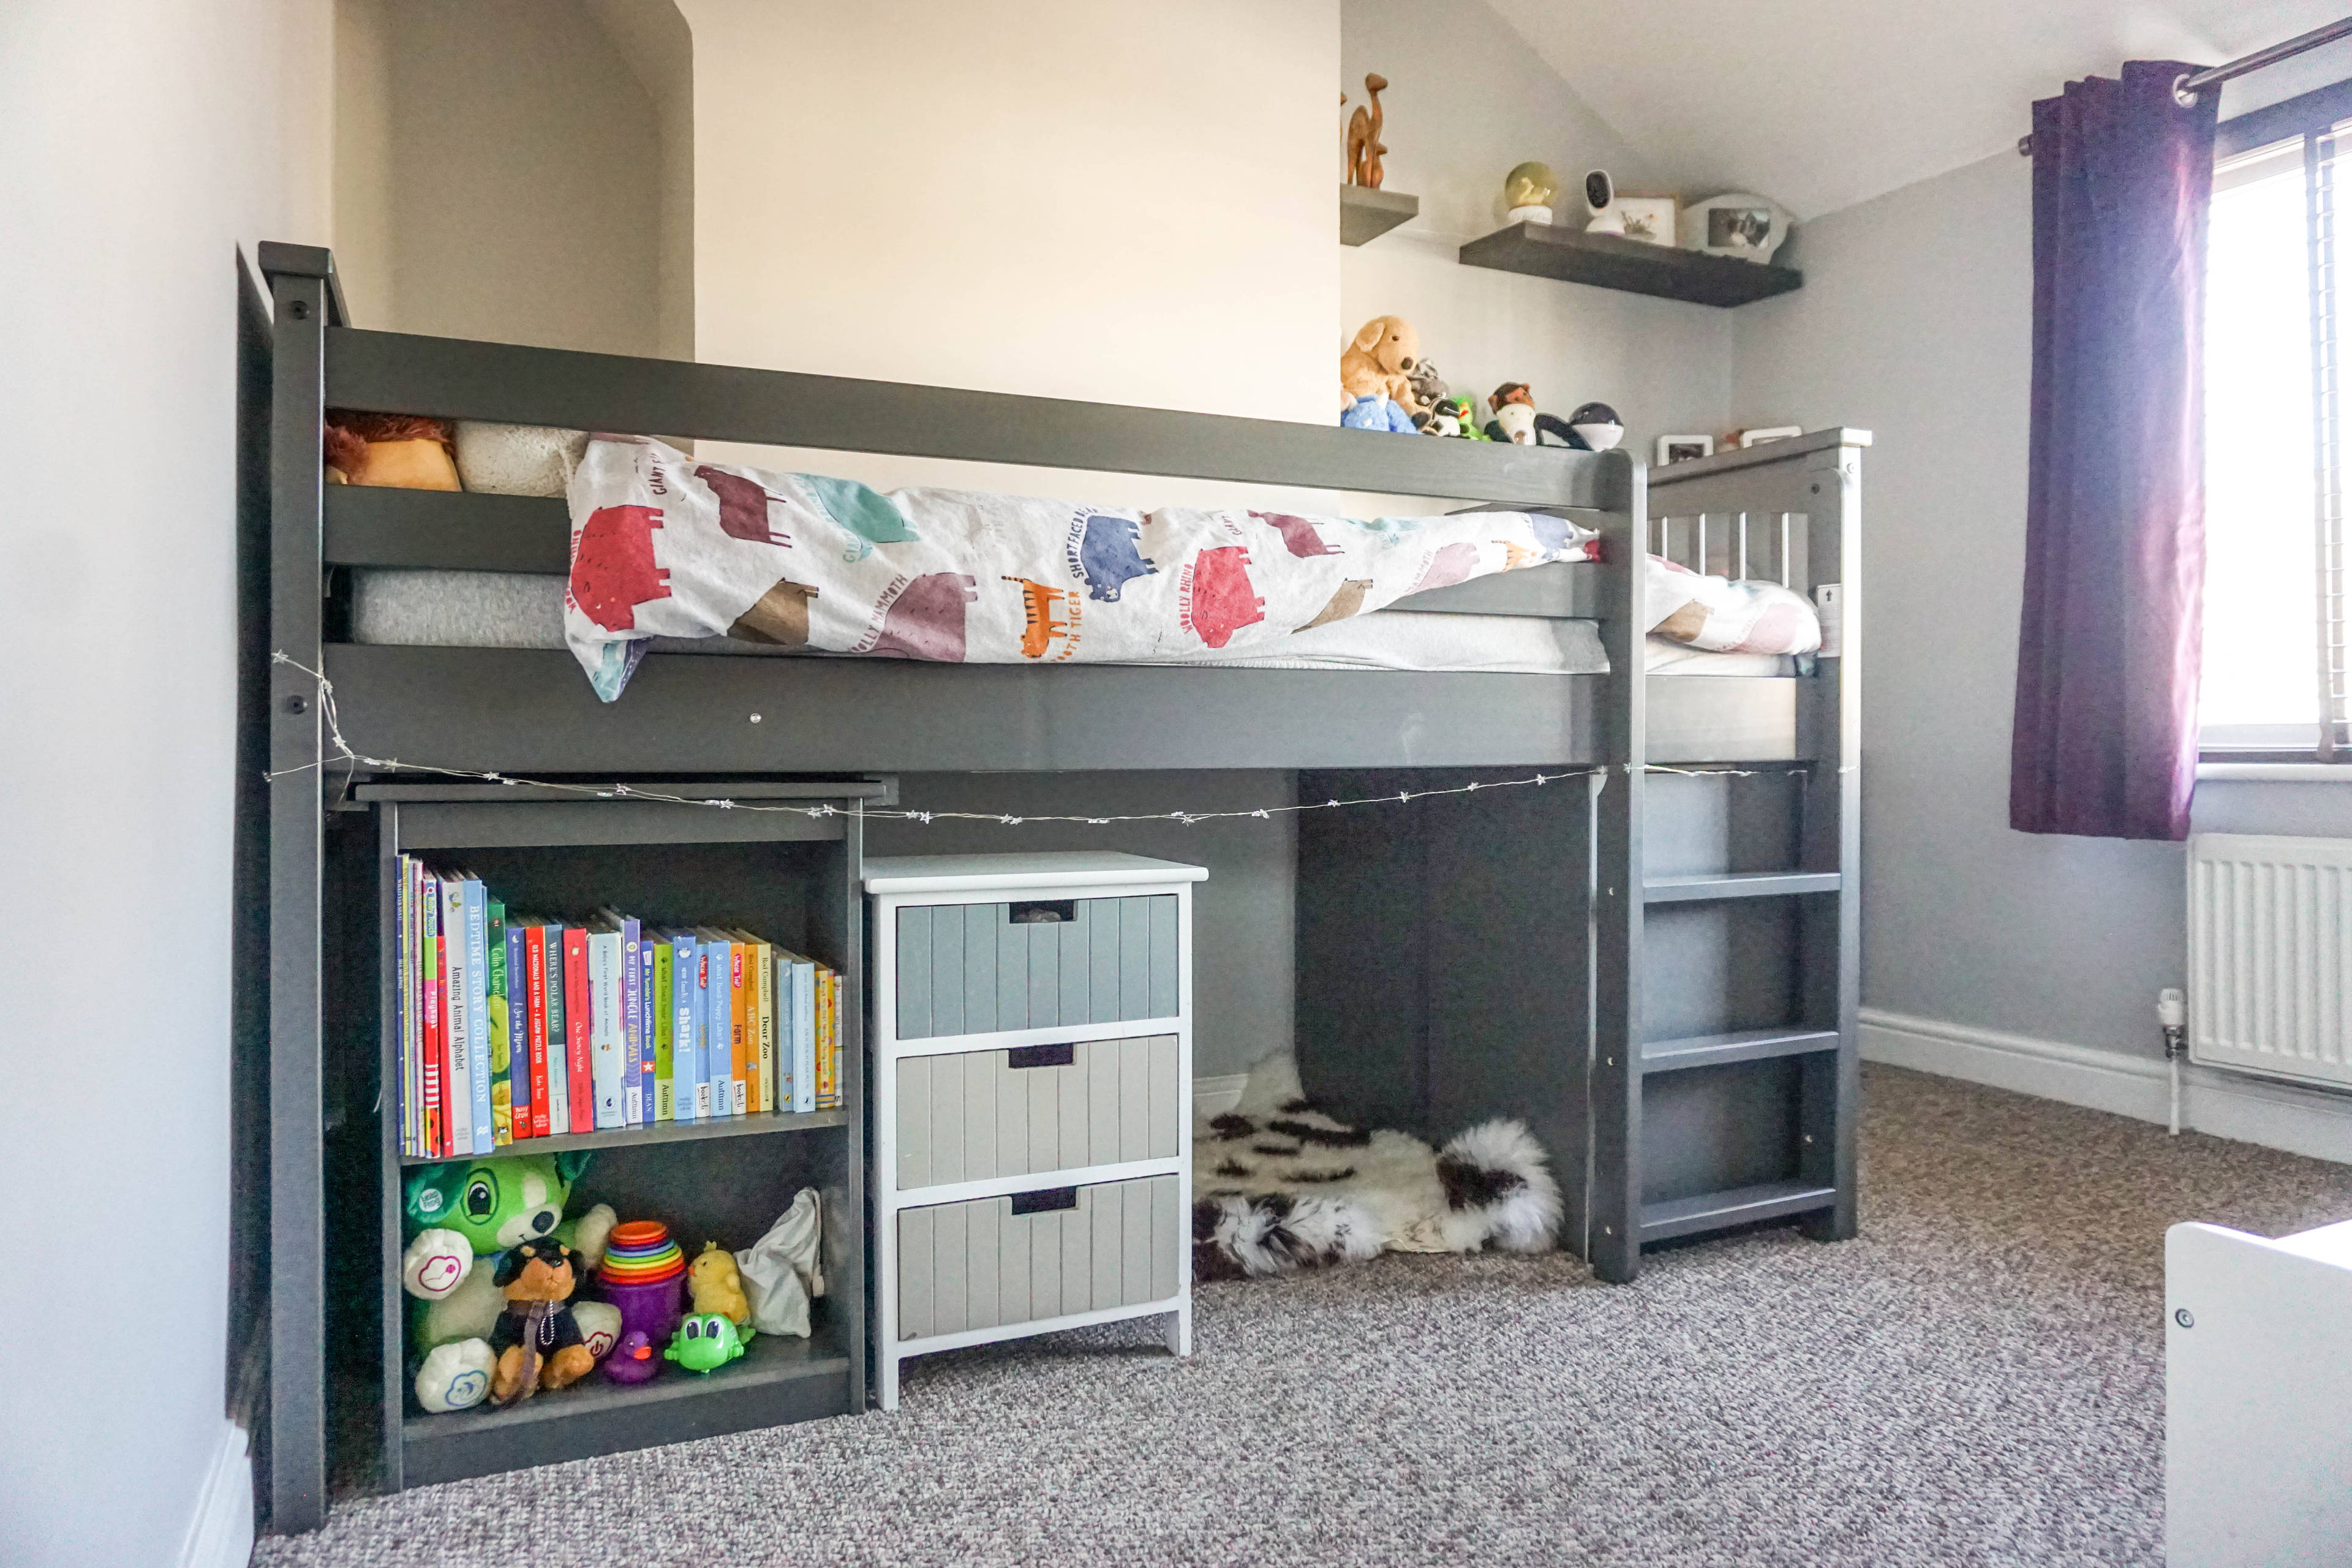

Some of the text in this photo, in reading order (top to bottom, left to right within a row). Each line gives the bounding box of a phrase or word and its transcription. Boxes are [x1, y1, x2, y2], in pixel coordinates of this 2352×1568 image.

[648, 466, 668, 496] GIANT
[1068, 518, 1084, 544] FACED
[1066, 544, 1084, 578] SHORT
[871, 573, 908, 624] MAMMOTH
[1068, 590, 1082, 628] TIGER
[1178, 564, 1194, 635] WOOLLY RHINO
[427, 896, 437, 936] Baby Touch
[491, 948, 503, 967] Colin
[470, 905, 486, 1102] BEDTIME STORY COLLECTION
[549, 941, 559, 1032] WHERE'S POLAR BEAR?
[451, 966, 466, 1071] Amazing Animal Alphabet
[627, 956, 638, 1063] MY FIRST JUNGLE ANIMALS
[715, 1000, 723, 1020] Puppy
[747, 1005, 756, 1027] ABC
[575, 1022, 583, 1033] One
[678, 1007, 692, 1052] shark!
[733, 1024, 742, 1044] Farm
[574, 1035, 584, 1055] Snowy
[574, 1057, 584, 1072] Night
